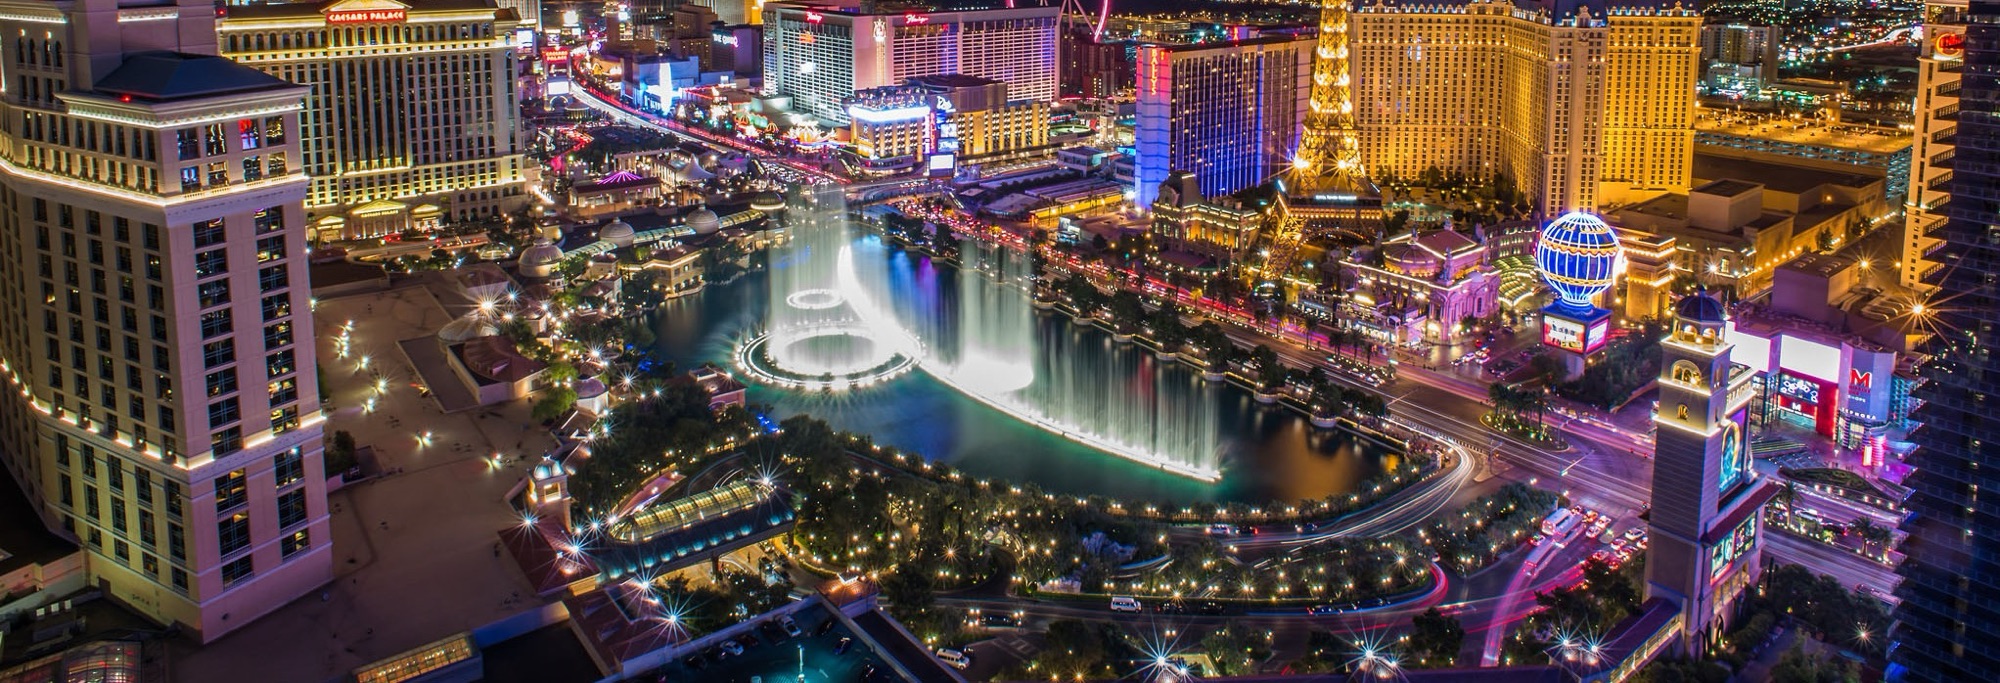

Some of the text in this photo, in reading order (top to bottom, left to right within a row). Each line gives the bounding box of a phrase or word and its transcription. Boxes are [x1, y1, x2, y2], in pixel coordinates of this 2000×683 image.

[329, 12, 403, 21] CAESARS PALACE
[1850, 368, 1873, 389] M
[1839, 407, 1877, 420] SEPHORA
